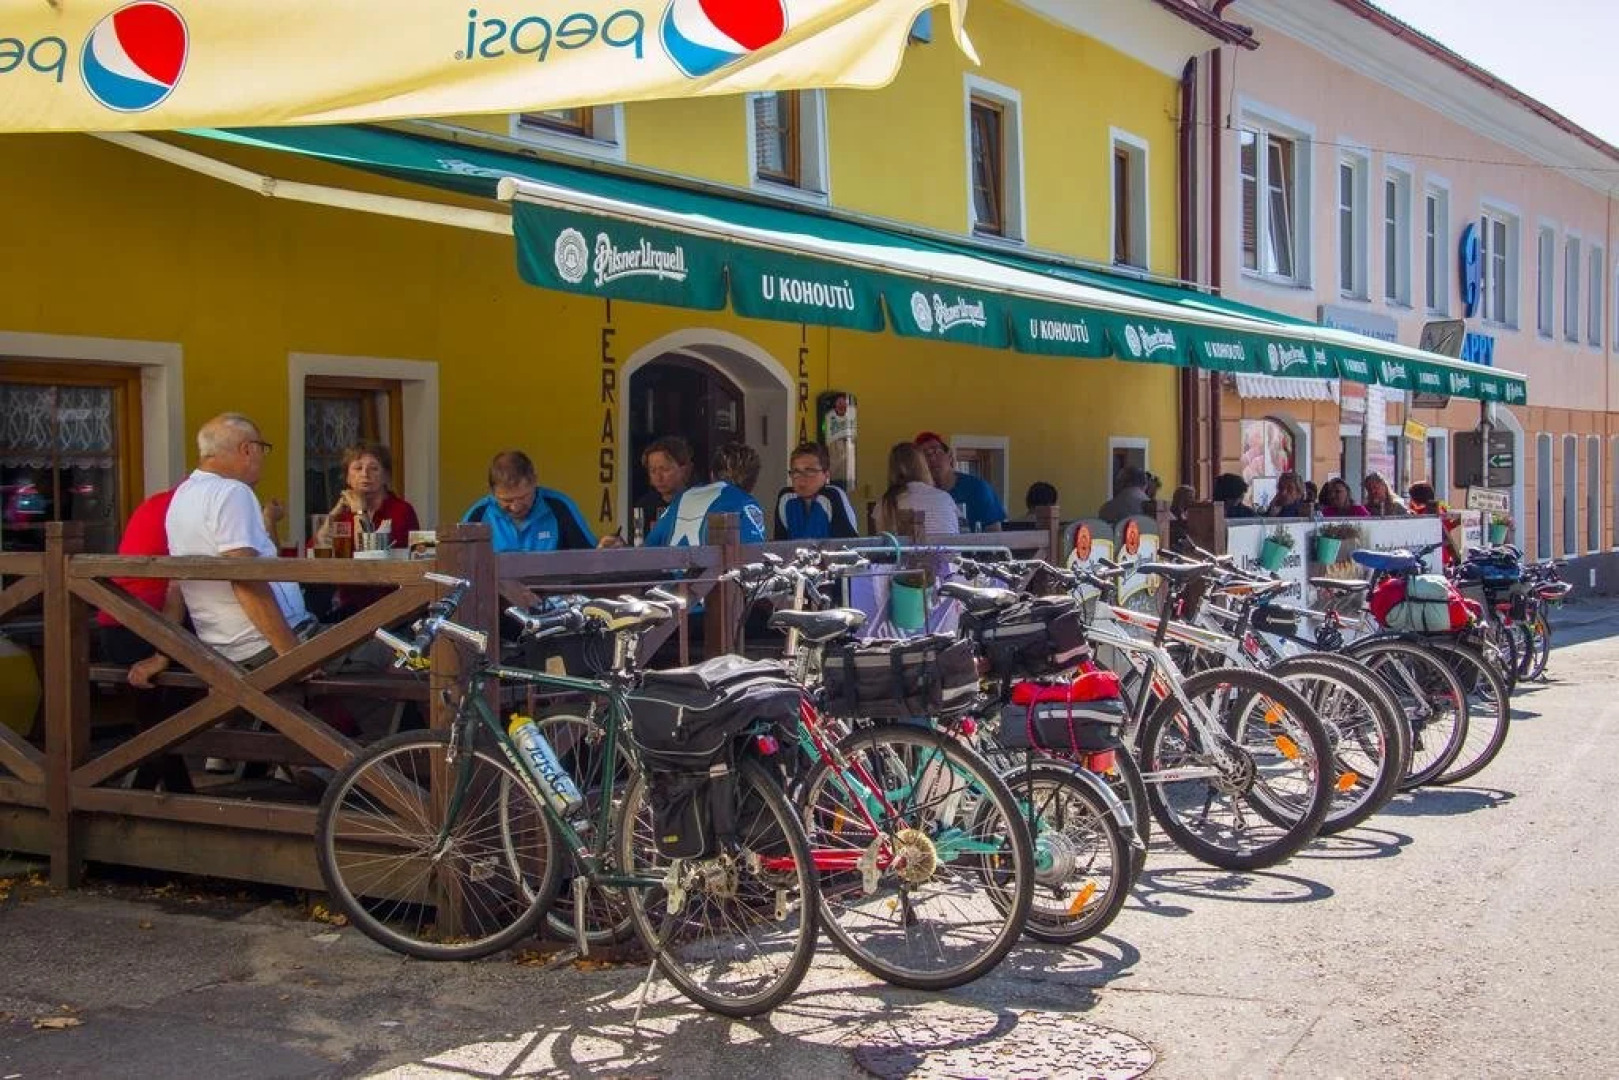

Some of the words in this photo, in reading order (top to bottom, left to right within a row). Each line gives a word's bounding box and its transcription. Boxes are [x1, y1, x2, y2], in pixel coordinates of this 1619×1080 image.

[593, 232, 642, 288] Pilsner
[640, 237, 687, 281] Urquell
[761, 274, 774, 300] U
[779, 279, 855, 311] KOHOUTŮ
[1030, 318, 1038, 340] U
